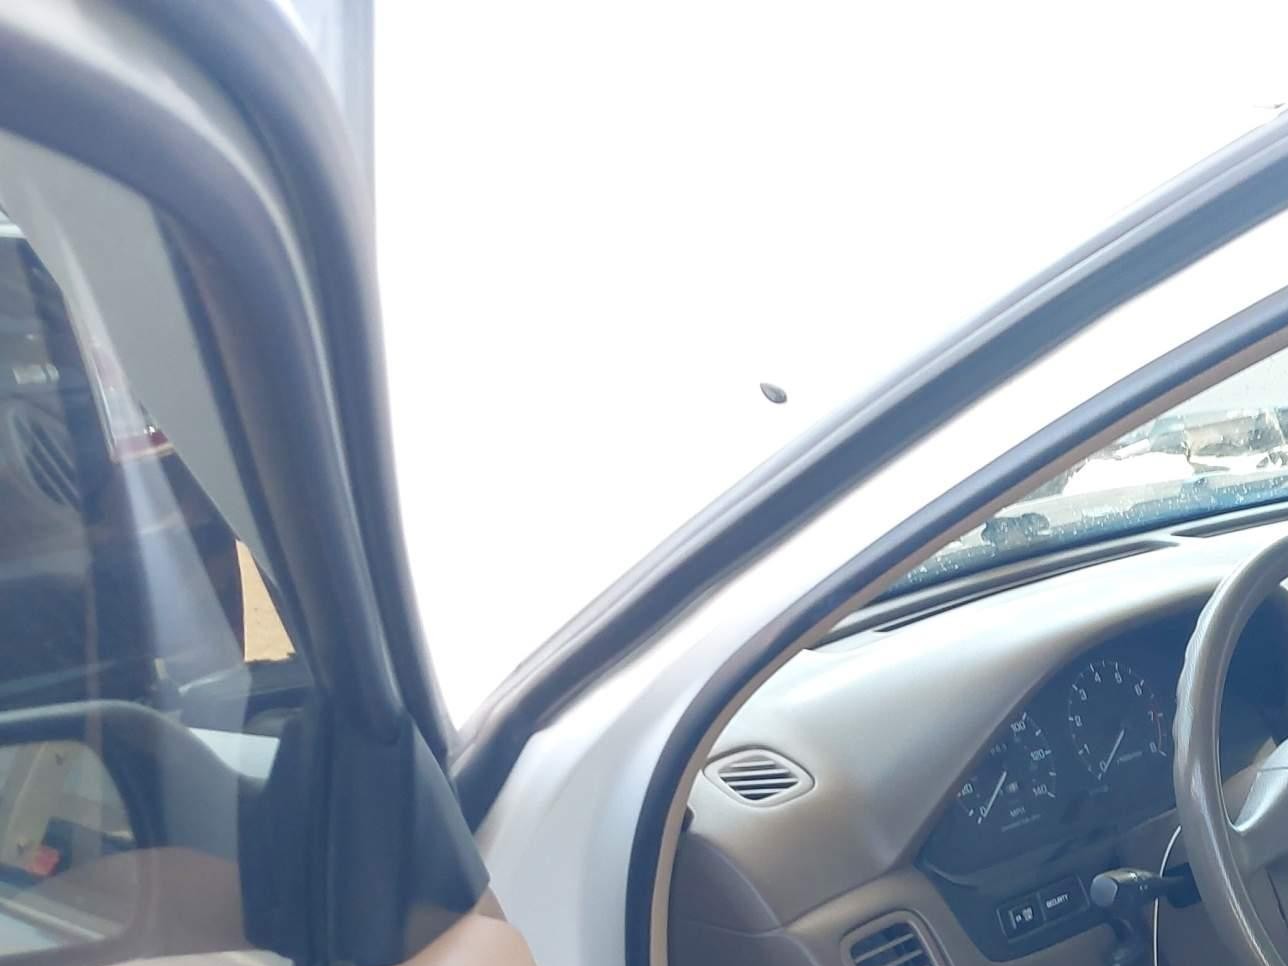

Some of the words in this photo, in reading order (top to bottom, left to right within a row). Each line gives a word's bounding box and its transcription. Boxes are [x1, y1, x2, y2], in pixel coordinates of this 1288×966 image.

[1094, 672, 1102, 683] 4
[1114, 672, 1122, 684] 5
[1079, 688, 1087, 701] 3
[1134, 684, 1142, 696] 6
[1147, 710, 1154, 721] 7
[1010, 720, 1026, 733] 100
[1099, 760, 1107, 772] 0
[1032, 784, 1047, 797] 140
[979, 806, 986, 816] 0
[1010, 806, 1026, 817] MPH
[1046, 893, 1069, 909] SECURITY
